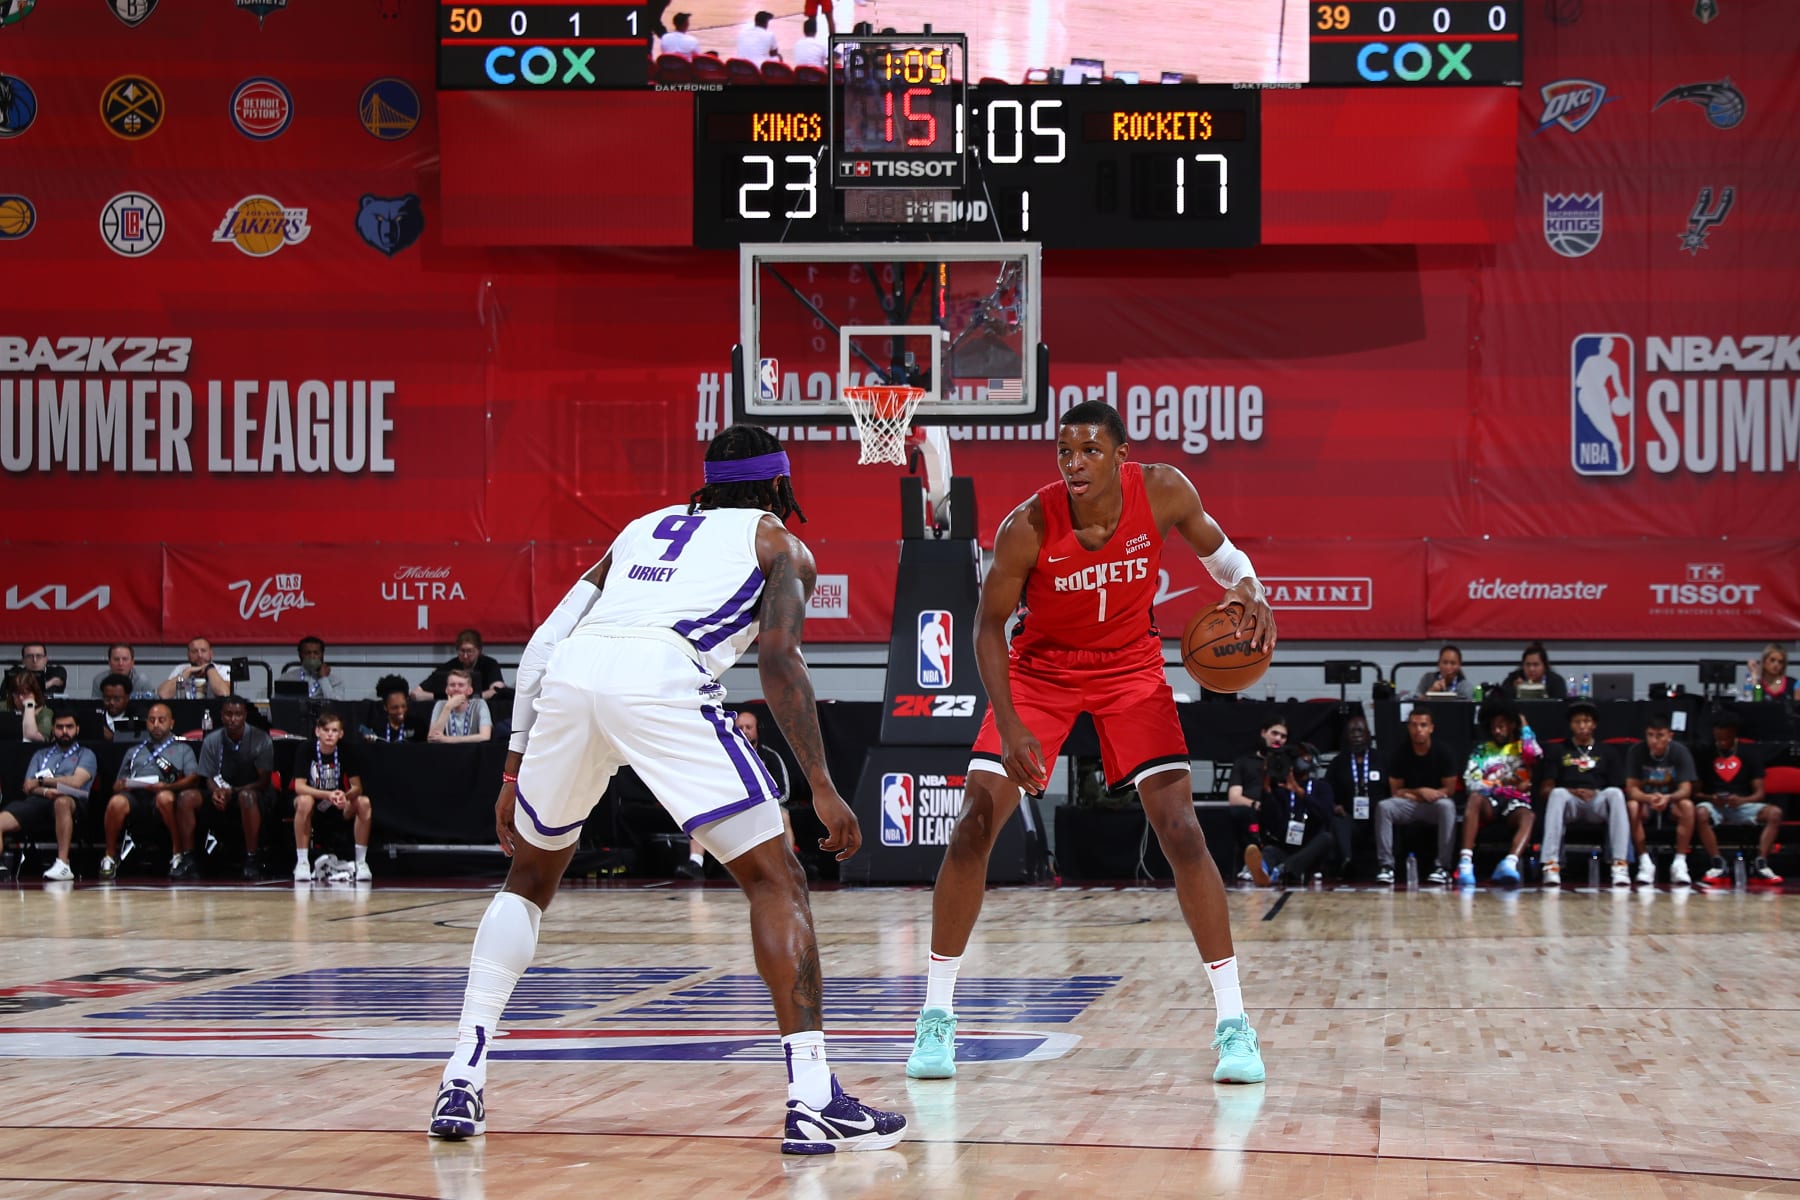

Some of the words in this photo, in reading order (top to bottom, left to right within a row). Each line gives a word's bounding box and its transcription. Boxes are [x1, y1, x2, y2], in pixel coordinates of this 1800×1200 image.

[449, 8, 483, 33] 50
[509, 10, 528, 36] 0
[568, 12, 581, 37] 1
[626, 11, 639, 36] 1
[1316, 5, 1351, 30] 39
[1378, 6, 1395, 32] 0
[1433, 8, 1450, 32] 0
[1488, 6, 1506, 31] 0
[485, 46, 596, 85] COX
[885, 50, 946, 83] 1:05
[1356, 42, 1473, 81] COX
[655, 83, 724, 92] DAKTRONICS
[243, 98, 279, 108] DETROIT
[243, 109, 280, 119] PISTONS
[752, 113, 822, 142] KINGS
[884, 88, 937, 146] 15
[1113, 112, 1213, 141] ROCKETS
[872, 161, 957, 176] TISSOT
[739, 155, 817, 219] 23
[1177, 154, 1228, 214] 17
[1021, 190, 1029, 232] 1
[222, 210, 303, 242] LAKERS
[1547, 219, 1600, 231] KINGS
[0, 336, 193, 372] BA2K23
[1645, 336, 1800, 371] NBA2K
[0, 379, 193, 472] UMMER
[208, 380, 395, 473] LEAGUE
[1645, 378, 1800, 474] SUMM
[1579, 442, 1610, 465] NBA
[652, 514, 707, 562] 9
[1125, 533, 1148, 547] credit
[1125, 540, 1151, 556] karma
[278, 575, 300, 590] LAS
[394, 566, 450, 580] Michelob
[628, 564, 678, 582] URKEY
[1054, 557, 1149, 593] ROCKETS
[228, 577, 316, 622] Vegas
[381, 582, 466, 600] ULTRA
[813, 584, 842, 596] NEW
[1467, 578, 1608, 600] ticketmaster
[1649, 584, 1761, 605] TISSOT
[811, 596, 842, 609] ERA
[1096, 587, 1107, 622] 1
[922, 669, 940, 684] NBA
[892, 694, 977, 717] 2K23
[919, 774, 968, 787] NBA2K
[885, 828, 901, 841] NBA
